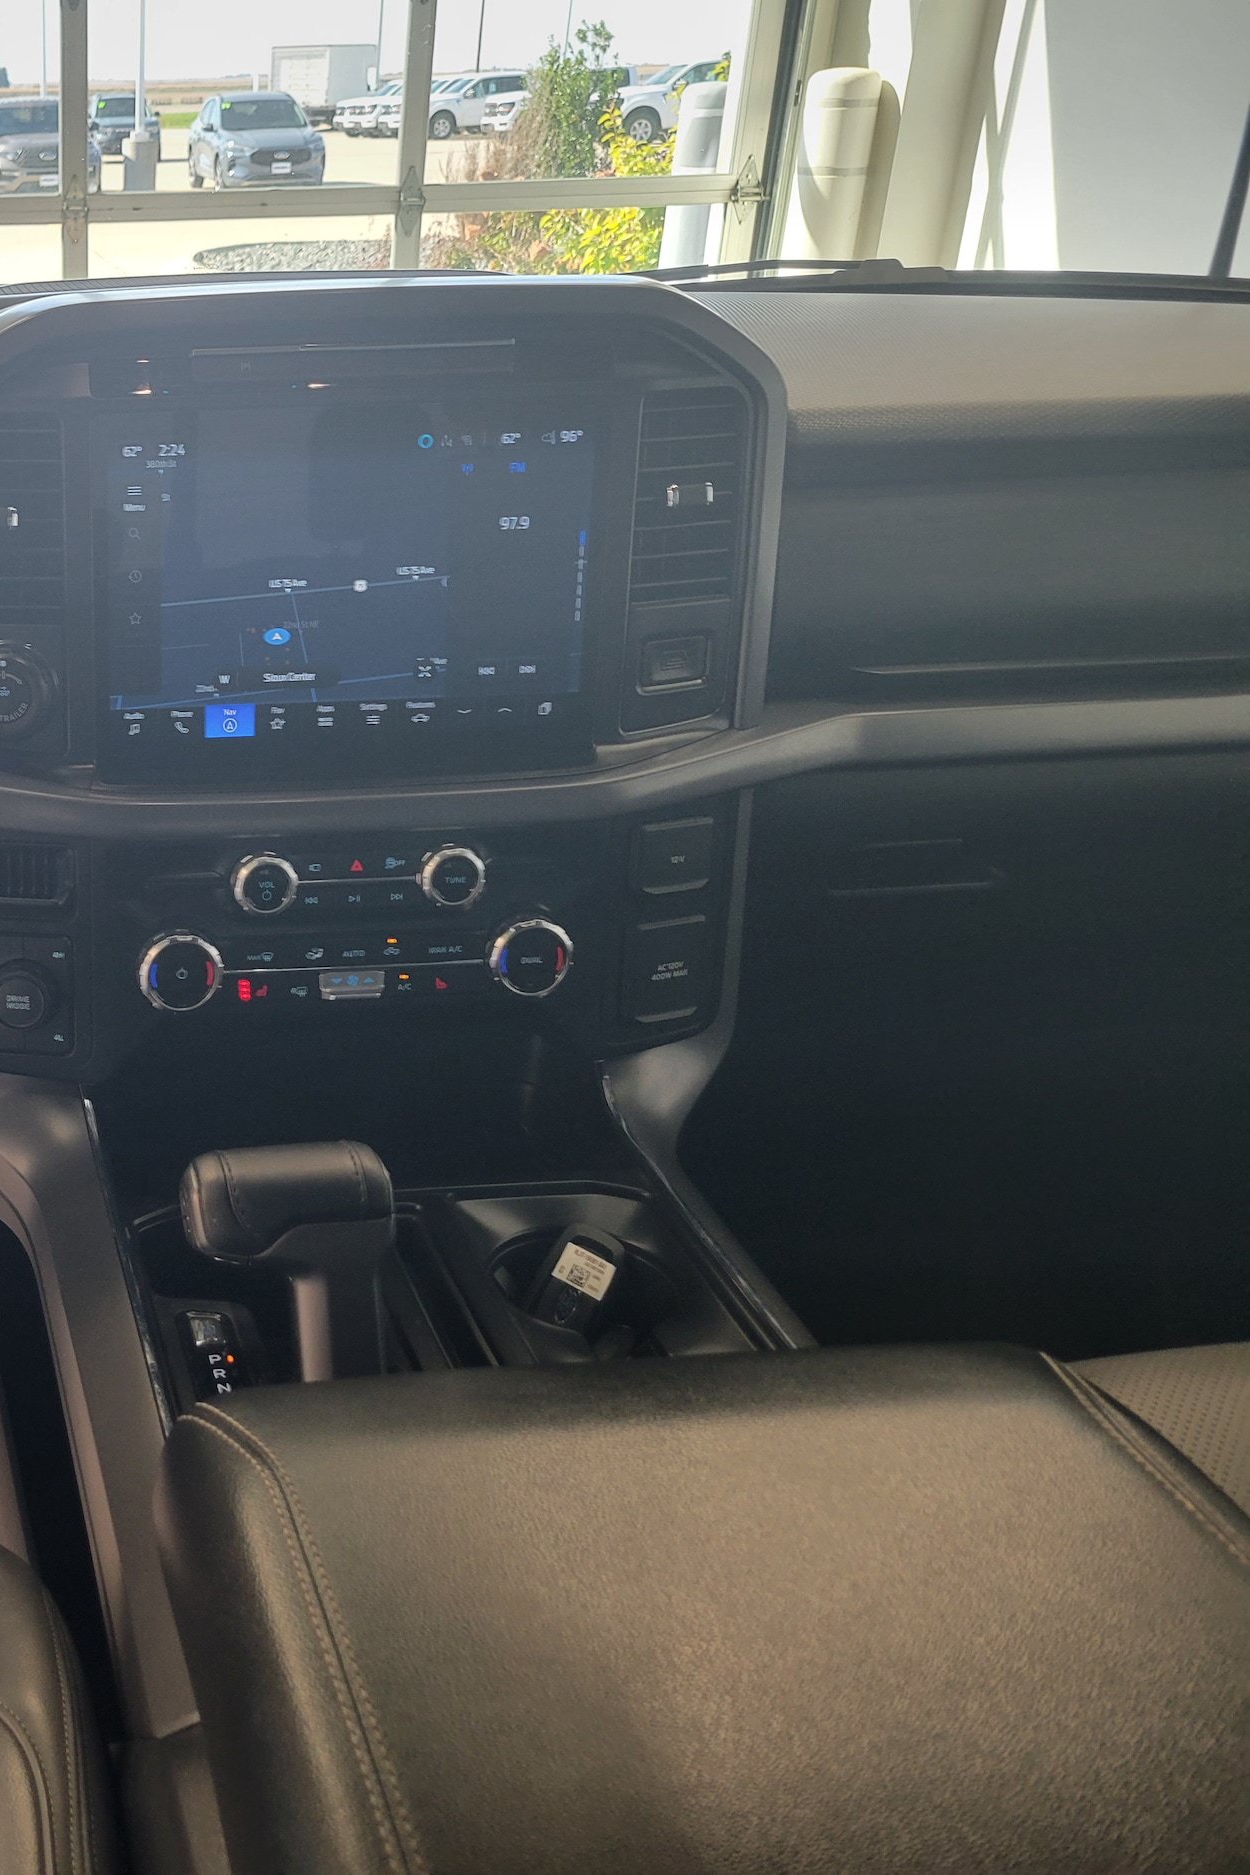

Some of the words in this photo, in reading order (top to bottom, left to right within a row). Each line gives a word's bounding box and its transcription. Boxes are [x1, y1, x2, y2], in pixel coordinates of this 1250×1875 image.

[499, 516, 530, 530] 97.9
[0, 702, 29, 722] TRAILER
[258, 881, 275, 889] VOL
[444, 876, 467, 884] TUNE
[398, 982, 412, 991] A/C
[208, 1354, 222, 1365] P
[212, 1368, 227, 1379] R
[216, 1382, 232, 1394] N
